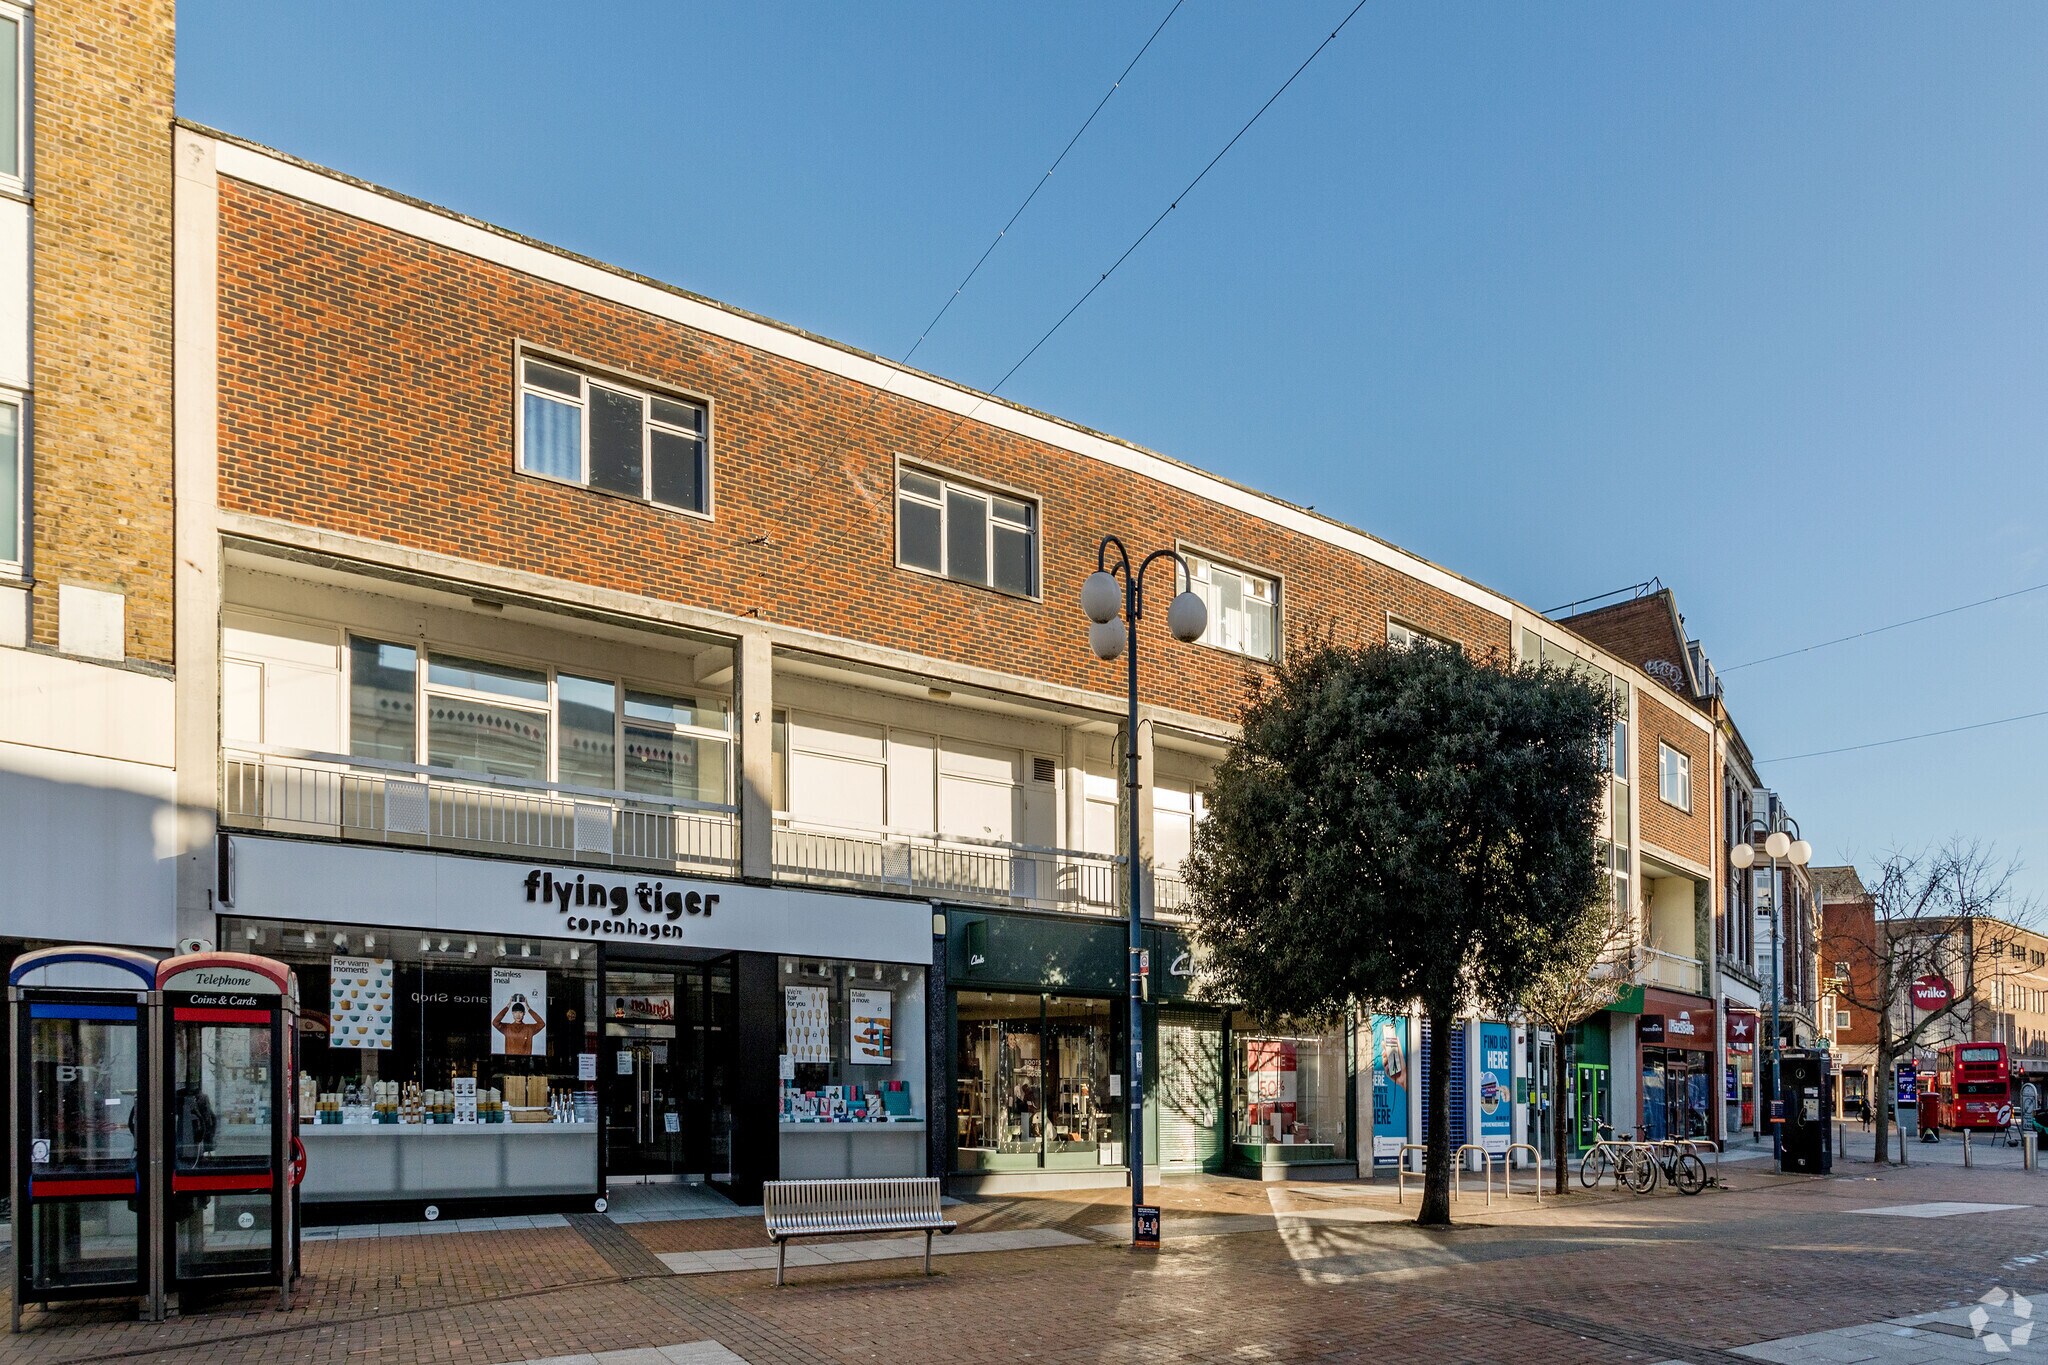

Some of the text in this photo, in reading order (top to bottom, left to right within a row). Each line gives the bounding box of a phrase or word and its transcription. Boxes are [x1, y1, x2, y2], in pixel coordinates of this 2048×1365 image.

[524, 869, 721, 921] flying tiger
[567, 916, 684, 940] copenhagen
[333, 958, 370, 968] For warm
[196, 973, 252, 987] Telephone
[493, 970, 522, 978] Stainless
[190, 994, 257, 1006] Coins & Cards
[1916, 986, 1947, 999] wilko
[1483, 1034, 1508, 1050] FIND US
[1487, 1050, 1509, 1070] HERE
[56, 1065, 98, 1082] BT
